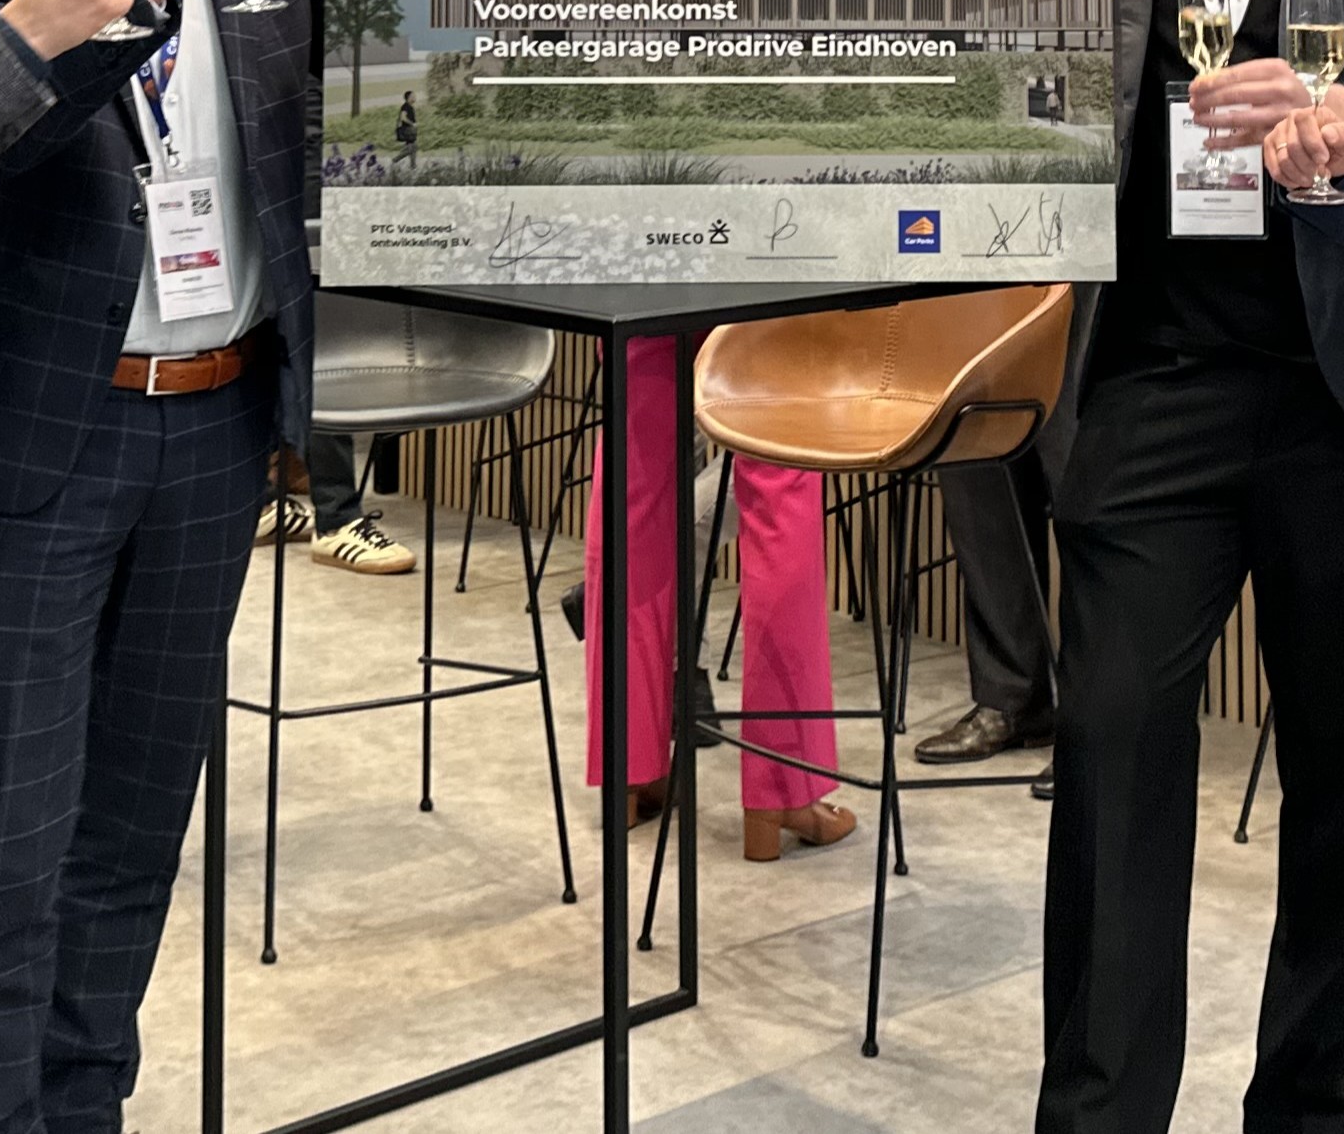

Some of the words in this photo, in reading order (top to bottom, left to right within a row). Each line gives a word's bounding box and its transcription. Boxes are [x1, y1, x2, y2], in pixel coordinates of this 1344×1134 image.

[474, 0, 738, 21] Voorovereenkomst
[474, 35, 681, 63] Parkeergarage
[688, 35, 804, 57] Prodrive
[812, 35, 957, 58] Eindhoven
[371, 224, 395, 234] PTC
[370, 237, 448, 249] ontwikkeling
[645, 232, 704, 245] SWECO
